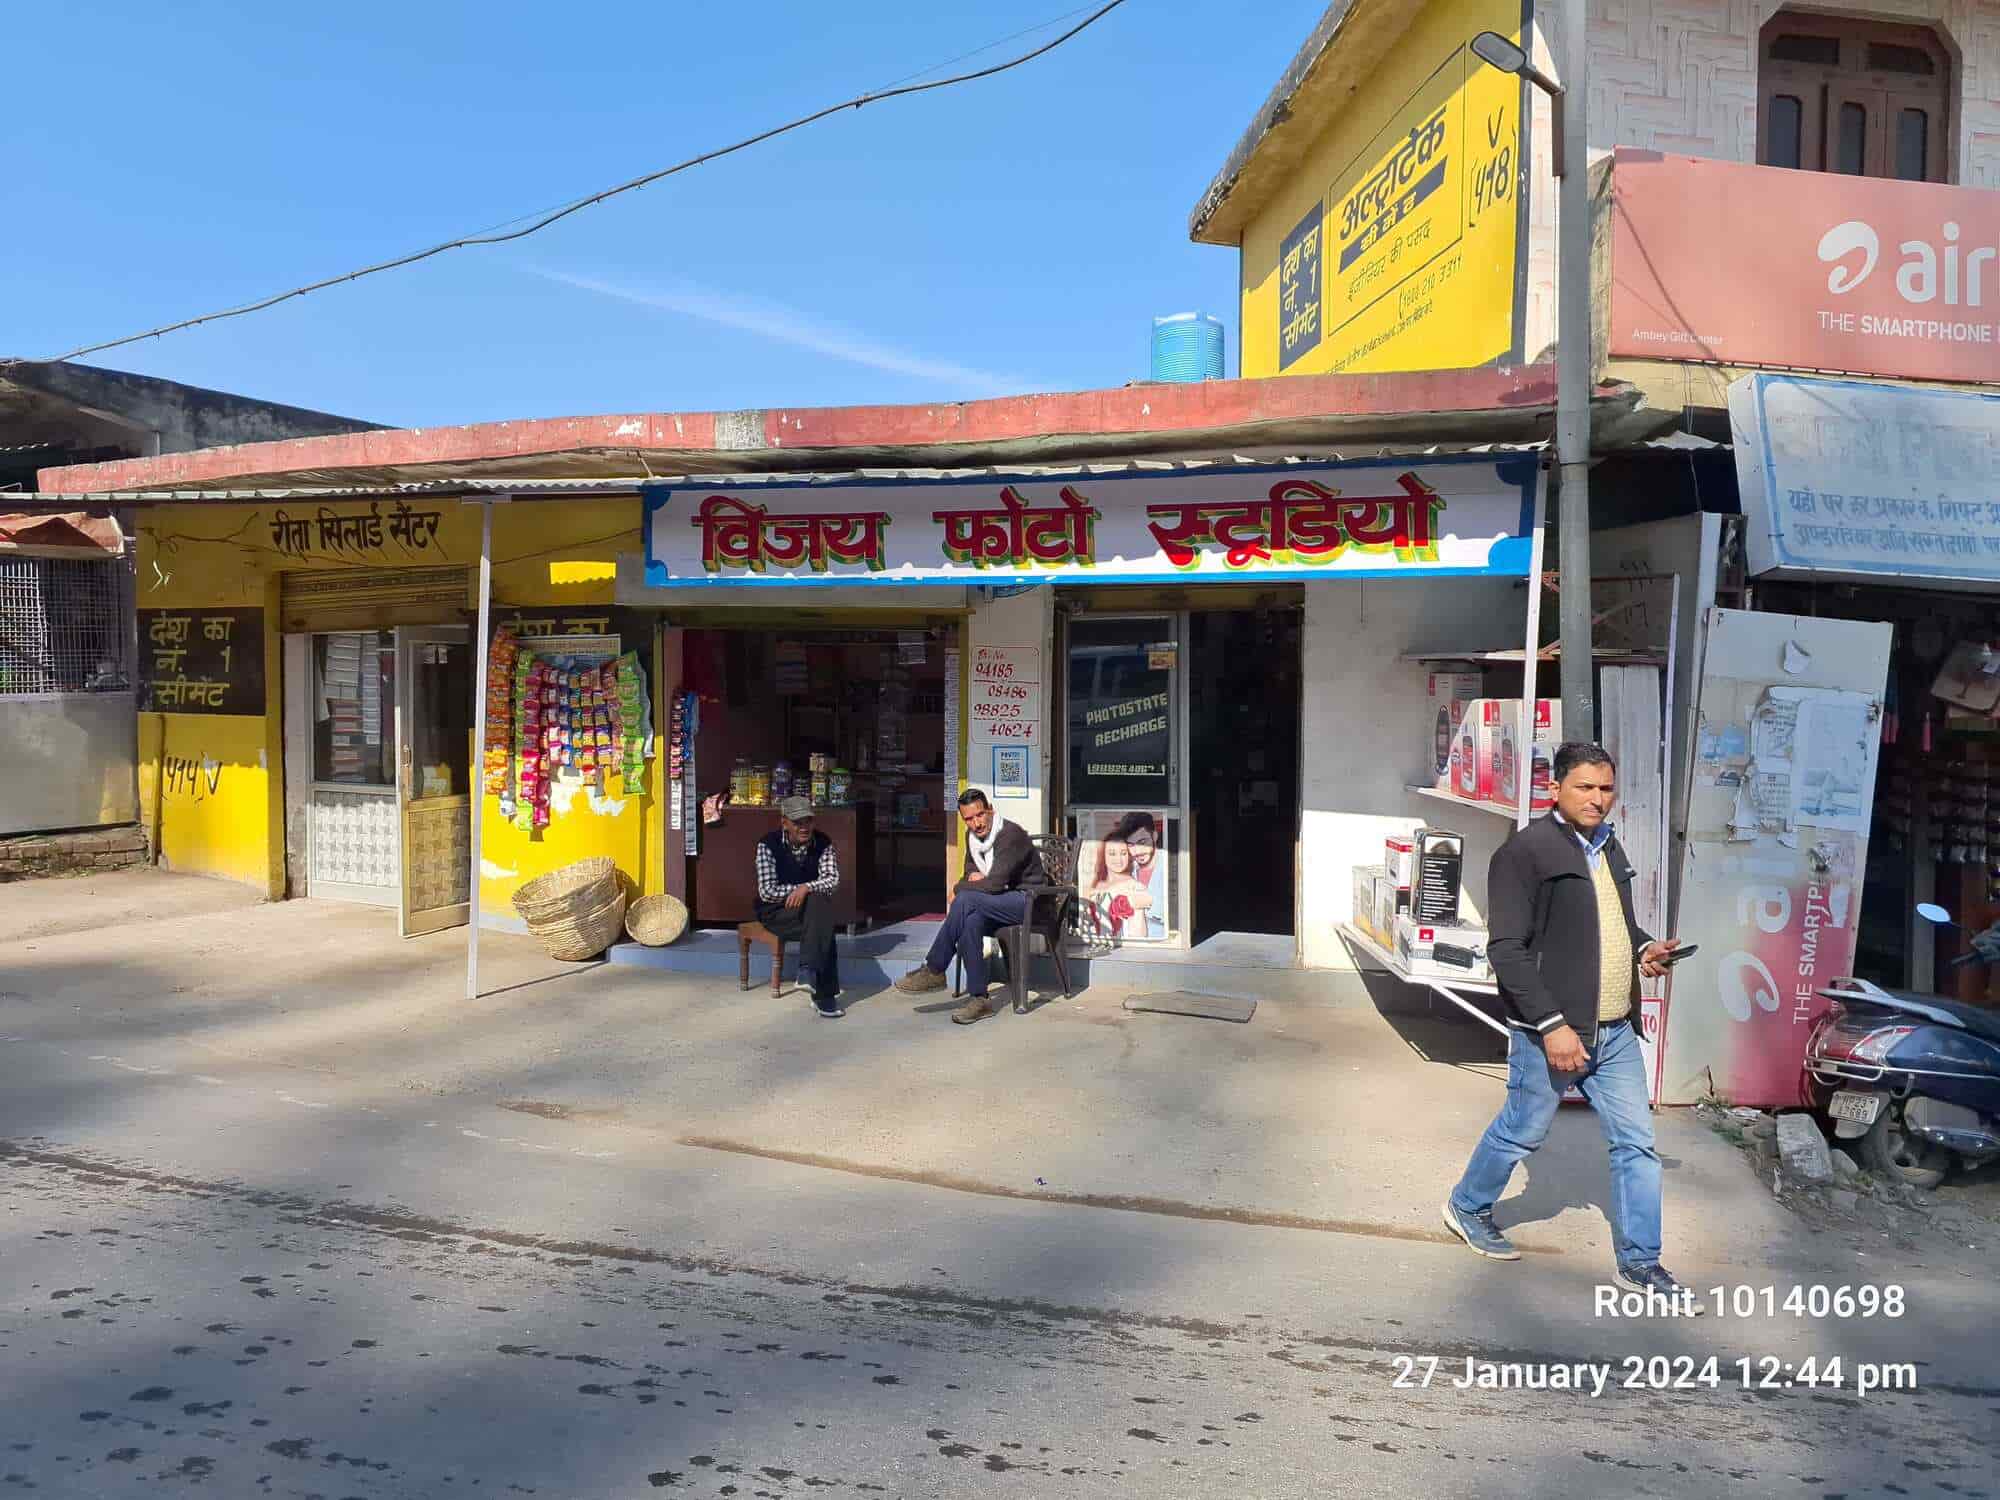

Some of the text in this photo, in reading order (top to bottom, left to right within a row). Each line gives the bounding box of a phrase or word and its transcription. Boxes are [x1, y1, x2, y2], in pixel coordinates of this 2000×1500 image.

[1896, 221, 2000, 306] air
[1817, 311, 1992, 342] THE SMARTPHONE
[316, 501, 385, 555] सिलाई
[690, 471, 1447, 573] विजय फोटो स्टूडियो
[202, 617, 235, 641] का
[1086, 692, 1168, 726] PHOTOSTATE
[1095, 715, 1167, 747] RECHARGE
[1793, 983, 1813, 1025] THE
